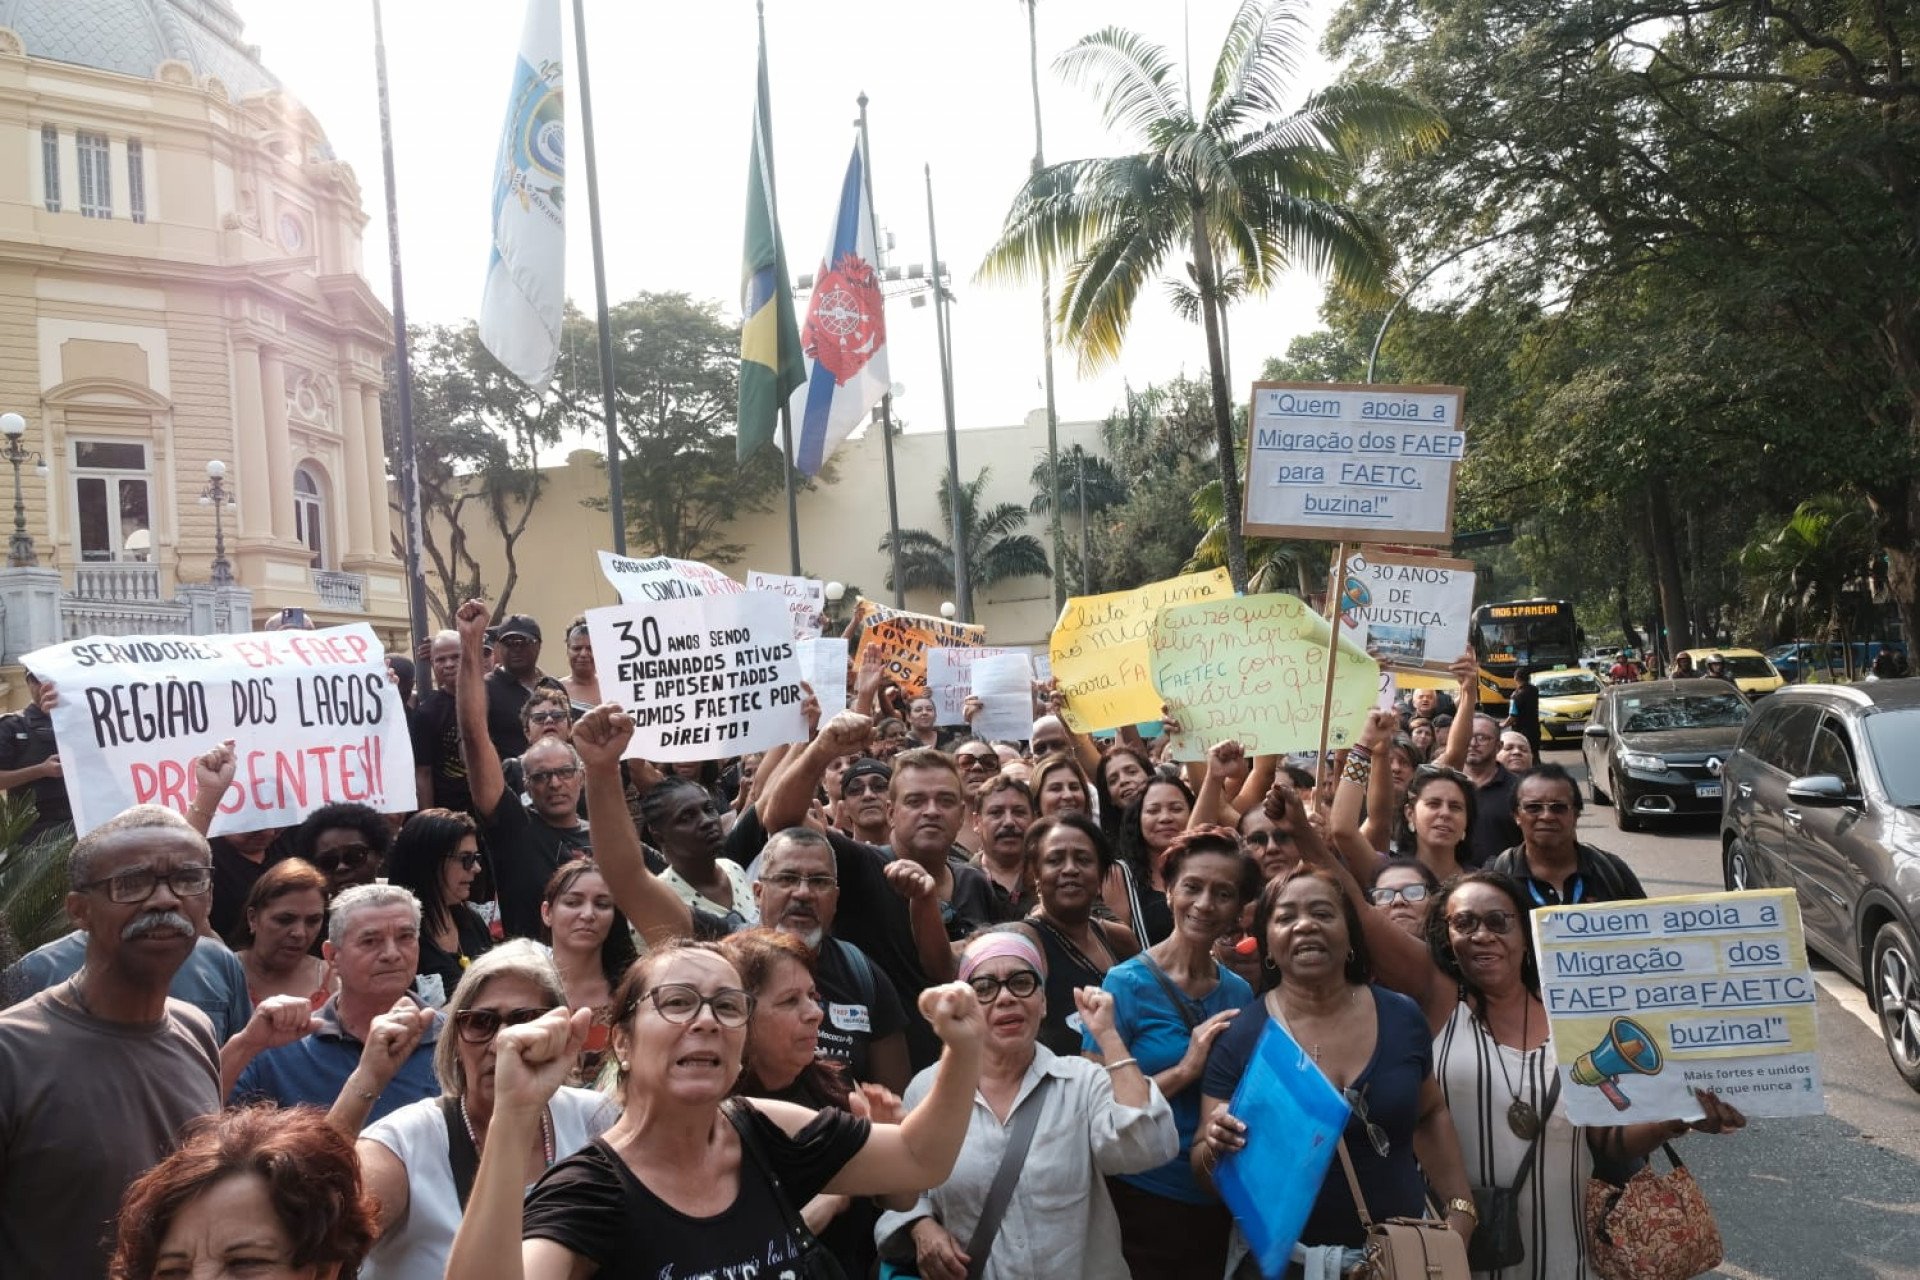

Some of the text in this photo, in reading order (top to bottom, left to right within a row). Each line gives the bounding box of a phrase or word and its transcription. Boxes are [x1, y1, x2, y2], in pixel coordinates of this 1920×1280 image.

[1270, 393, 1445, 421] "Quem apoia a
[1258, 428, 1464, 453] Migração dos FAEP
[1279, 465, 1325, 483] para
[1305, 493, 1388, 514] buzina!"
[1372, 565, 1394, 580] 30
[1397, 567, 1449, 585] ANOS
[1389, 588, 1412, 604] DE
[1164, 607, 1199, 630] Eu
[71, 634, 369, 669] SERVIDORES EX-FAEP
[613, 616, 751, 660] 30 ANOS SENDO
[617, 653, 726, 682] ENGANADOS
[1238, 653, 1297, 676] com
[633, 665, 779, 702] E APOSENTADOS
[85, 673, 384, 748] REGIÃO DOS LAGOS
[694, 691, 763, 720] FAETEC
[771, 684, 801, 708] POR
[1554, 904, 1776, 934] "Quem apoia a
[1556, 941, 1780, 975] Migração dos
[1550, 985, 1627, 1010] FAEP
[1635, 983, 1697, 1008] para
[1670, 1016, 1783, 1044] buzina!"
[1684, 1064, 1811, 1081] Mais fortes e unidos
[1726, 1083, 1749, 1096] que
[1753, 1081, 1793, 1092] nunca
